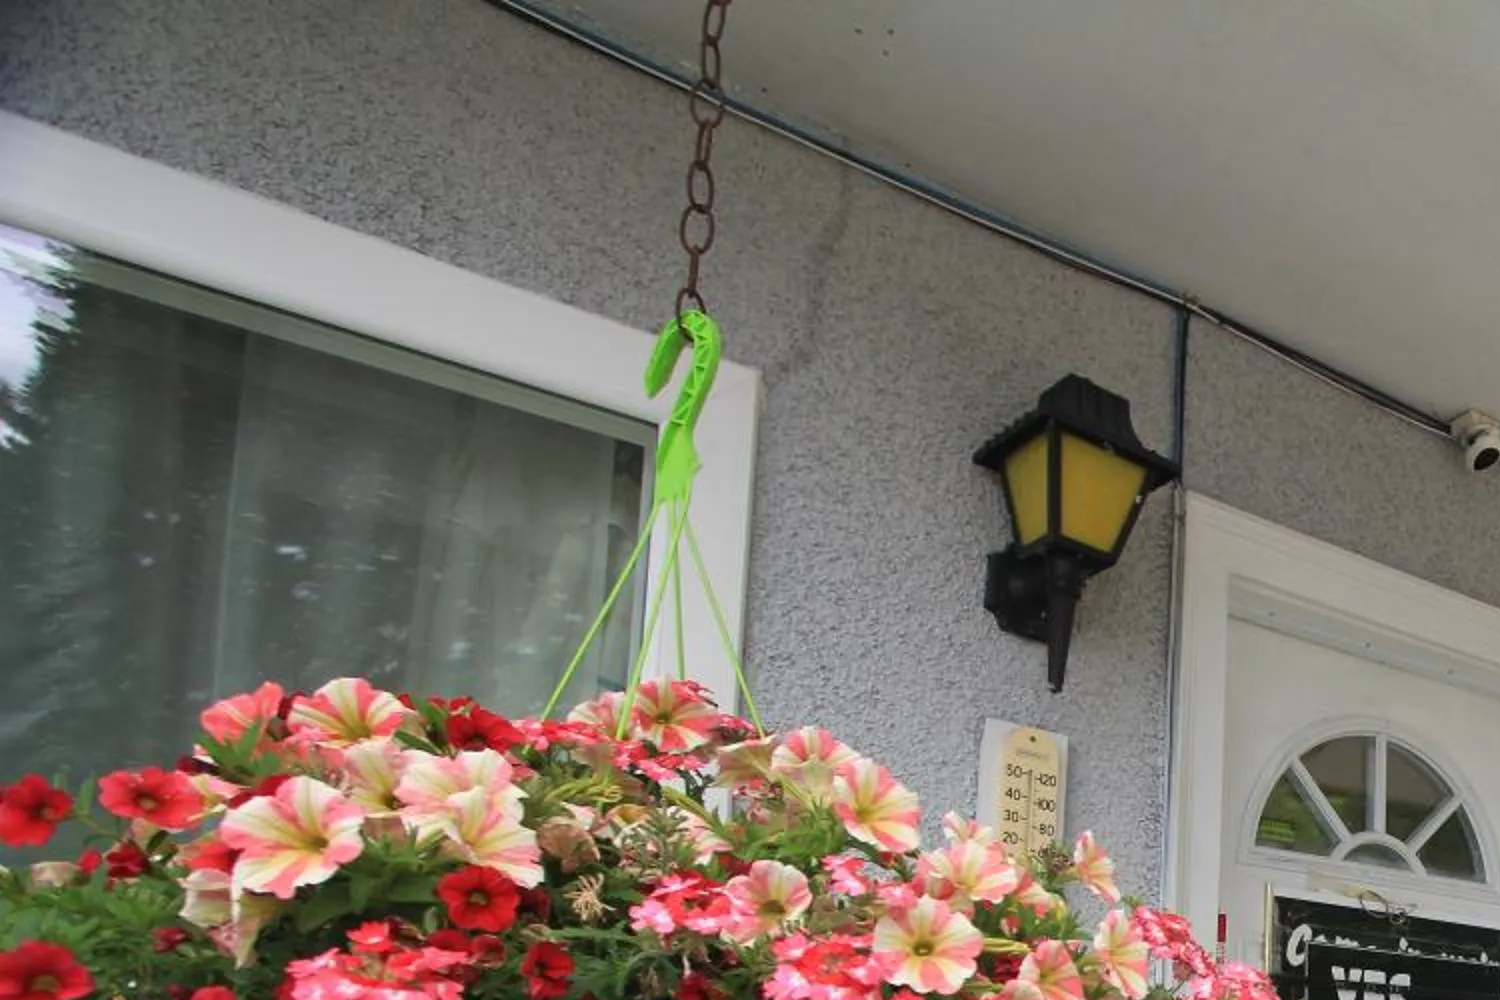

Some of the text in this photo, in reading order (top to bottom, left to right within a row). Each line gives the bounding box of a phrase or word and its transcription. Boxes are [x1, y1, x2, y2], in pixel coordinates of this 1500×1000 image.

[1006, 763, 1022, 778] 50
[1005, 787, 1021, 801] 40
[1003, 809, 1019, 823] 30
[1003, 831, 1019, 845] 20
